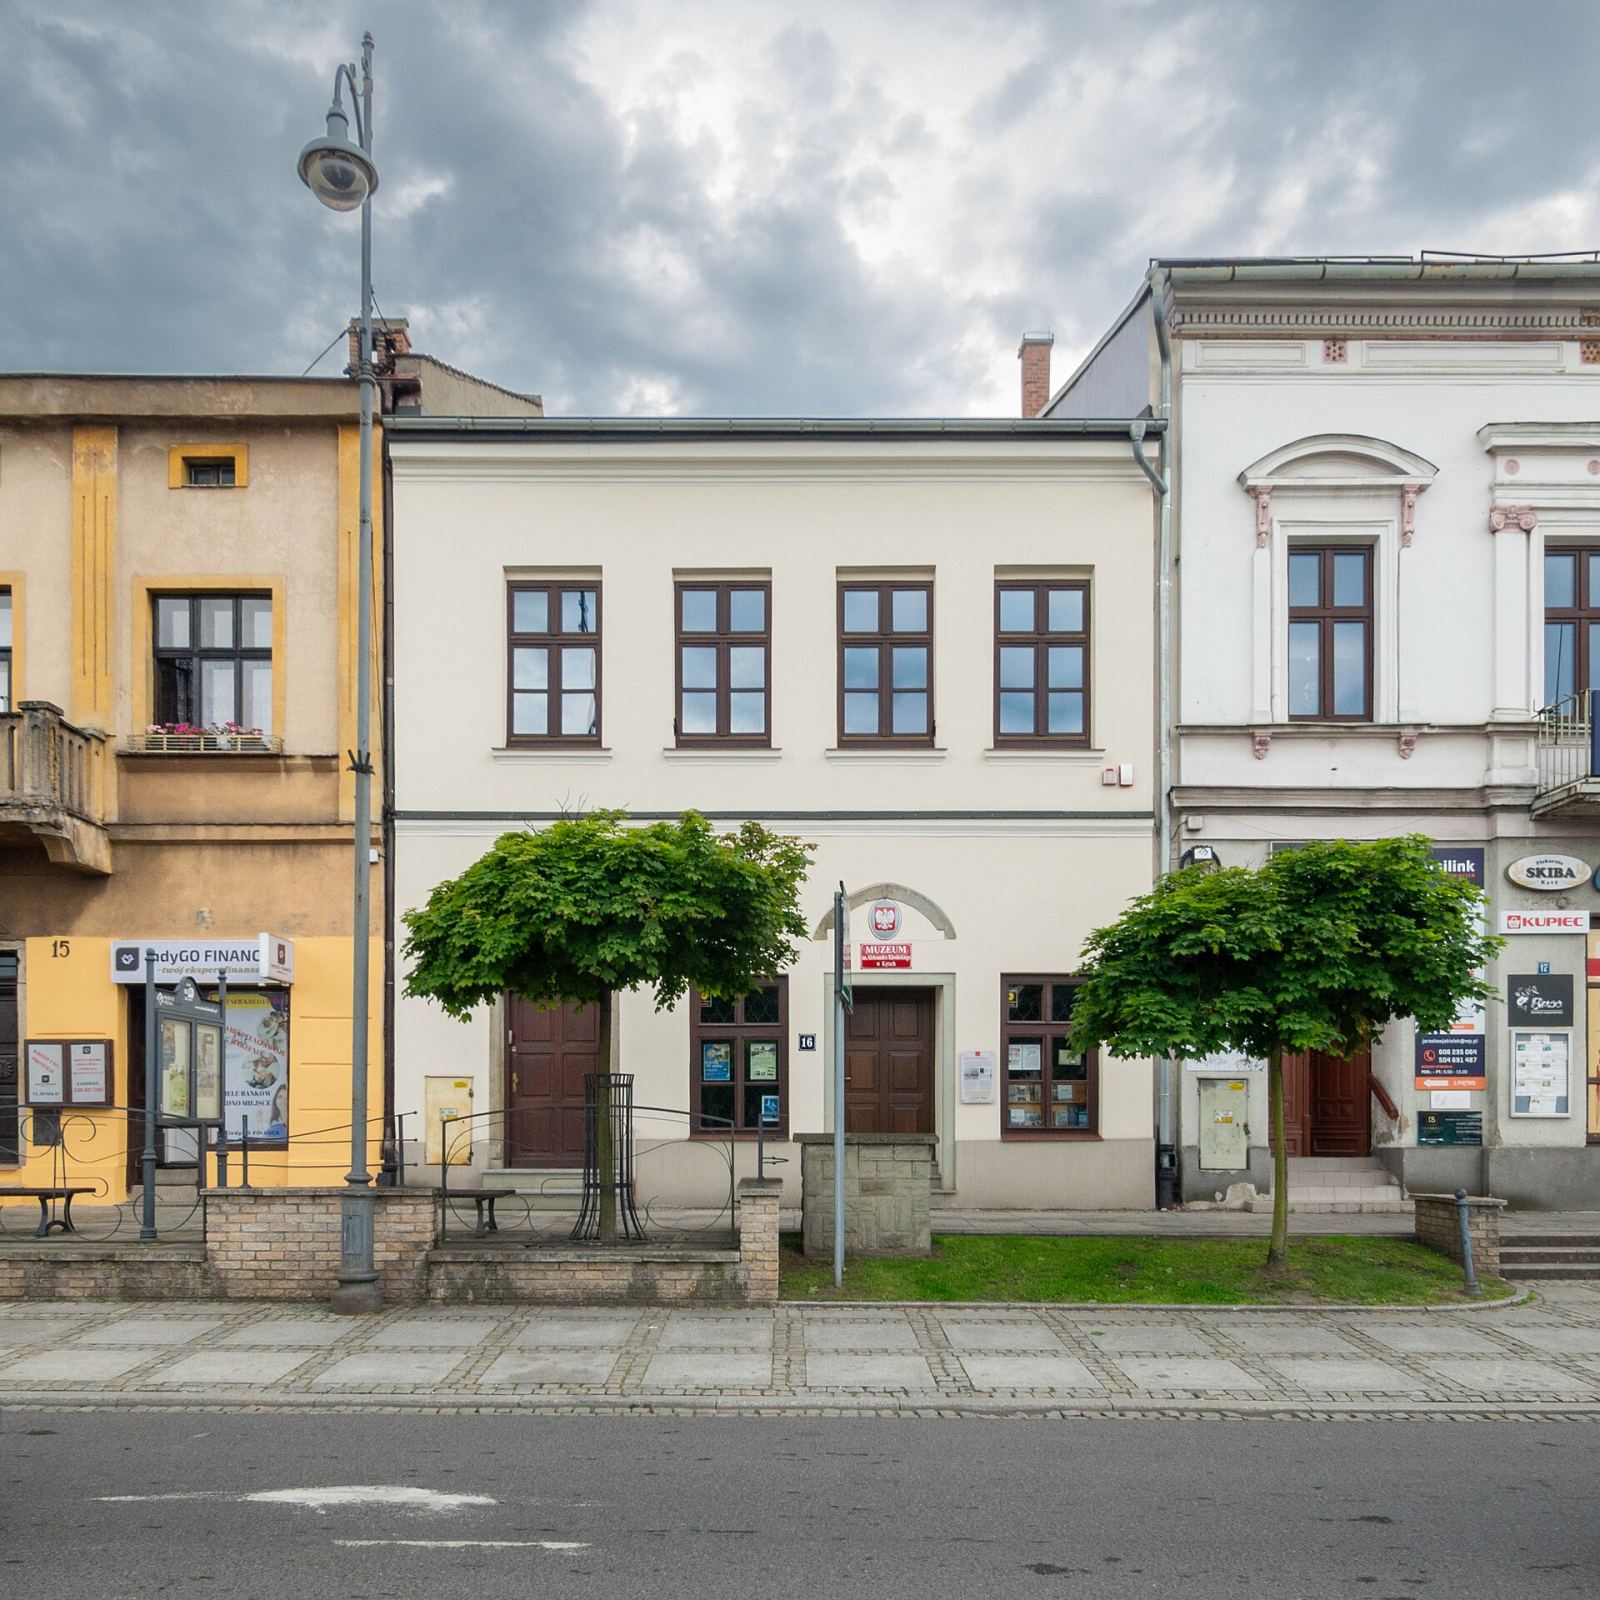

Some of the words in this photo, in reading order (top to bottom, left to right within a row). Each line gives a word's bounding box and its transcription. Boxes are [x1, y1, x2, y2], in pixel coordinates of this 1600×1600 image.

[1526, 867, 1576, 879] SKIBA
[1522, 916, 1584, 927] KUPIEC
[52, 940, 70, 958] 15
[865, 945, 907, 954] MUZEUM
[801, 1037, 813, 1048] 16
